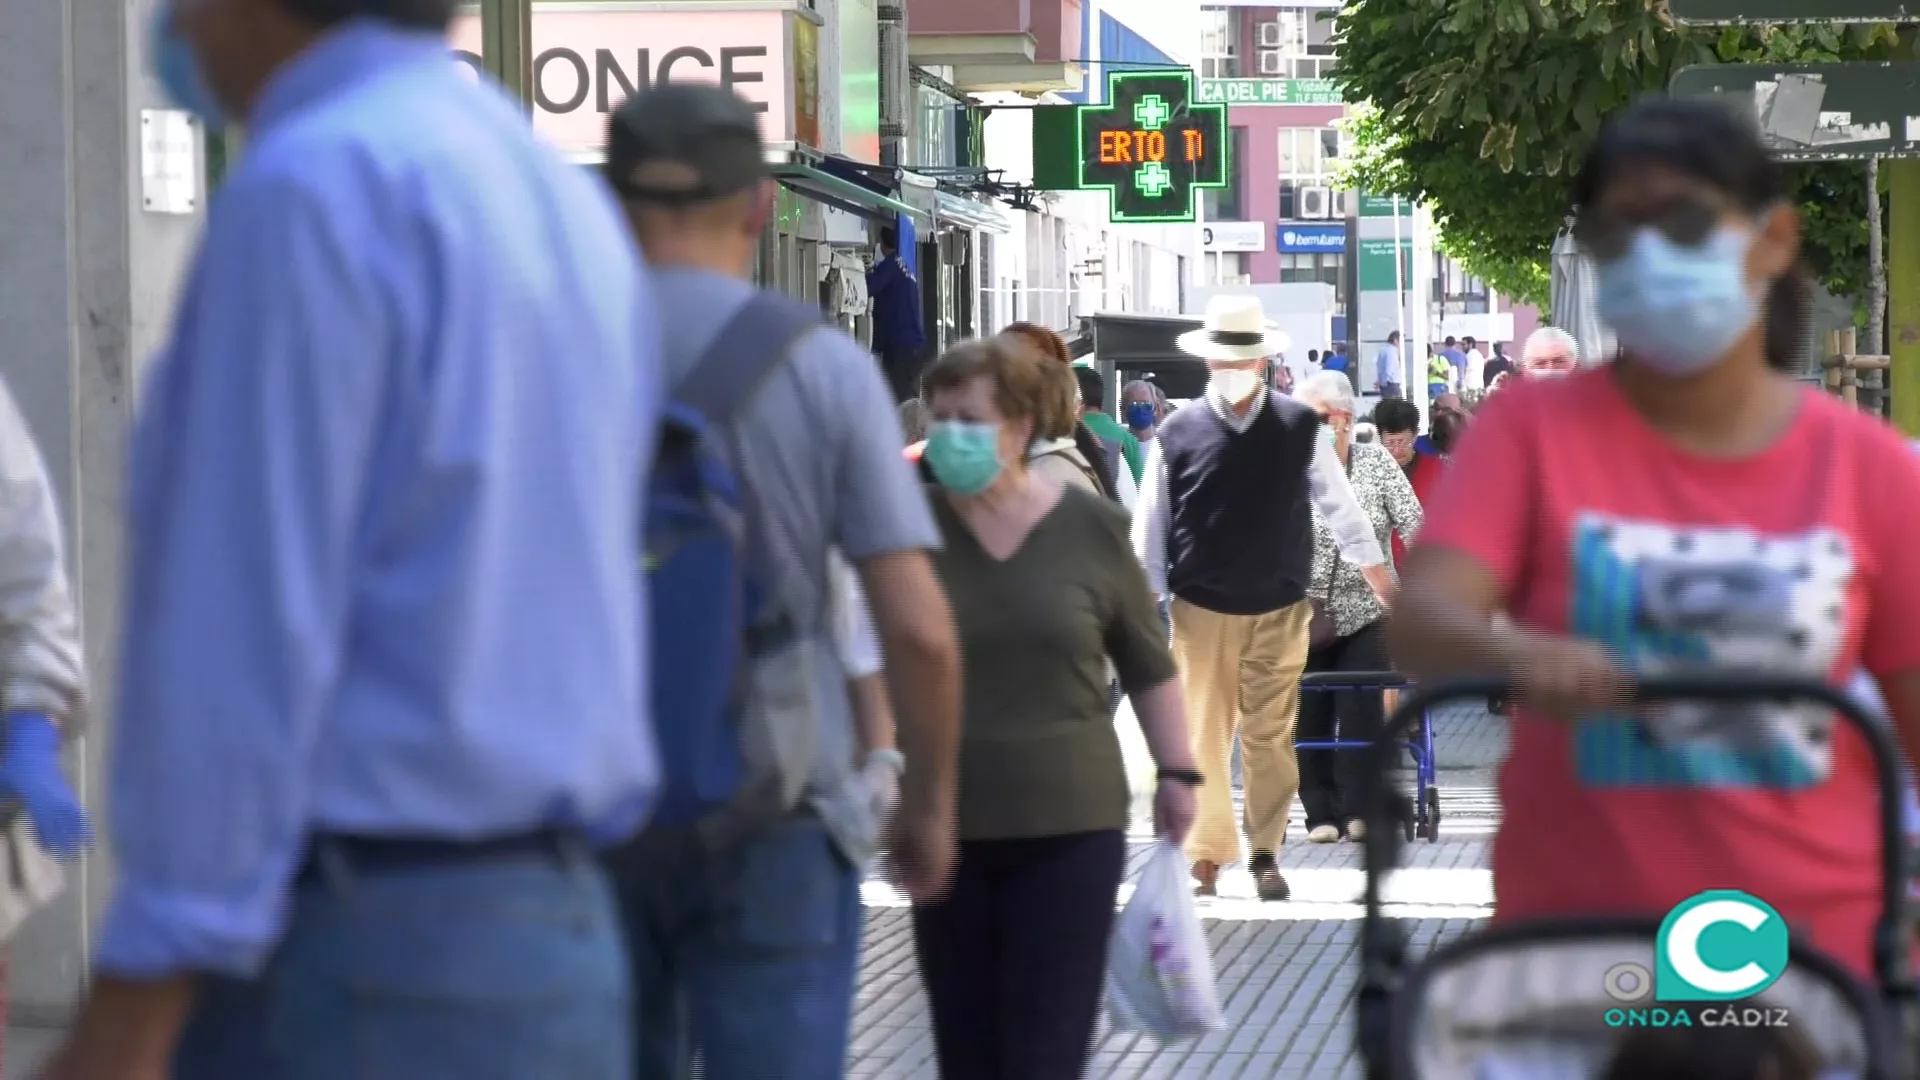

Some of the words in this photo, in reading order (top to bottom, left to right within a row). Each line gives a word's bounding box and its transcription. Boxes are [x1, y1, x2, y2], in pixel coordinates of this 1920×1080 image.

[534, 46, 769, 114] ONCE
[1227, 82, 1259, 100] DEL
[1262, 82, 1288, 100] PIE
[1100, 130, 1165, 163] ERTO
